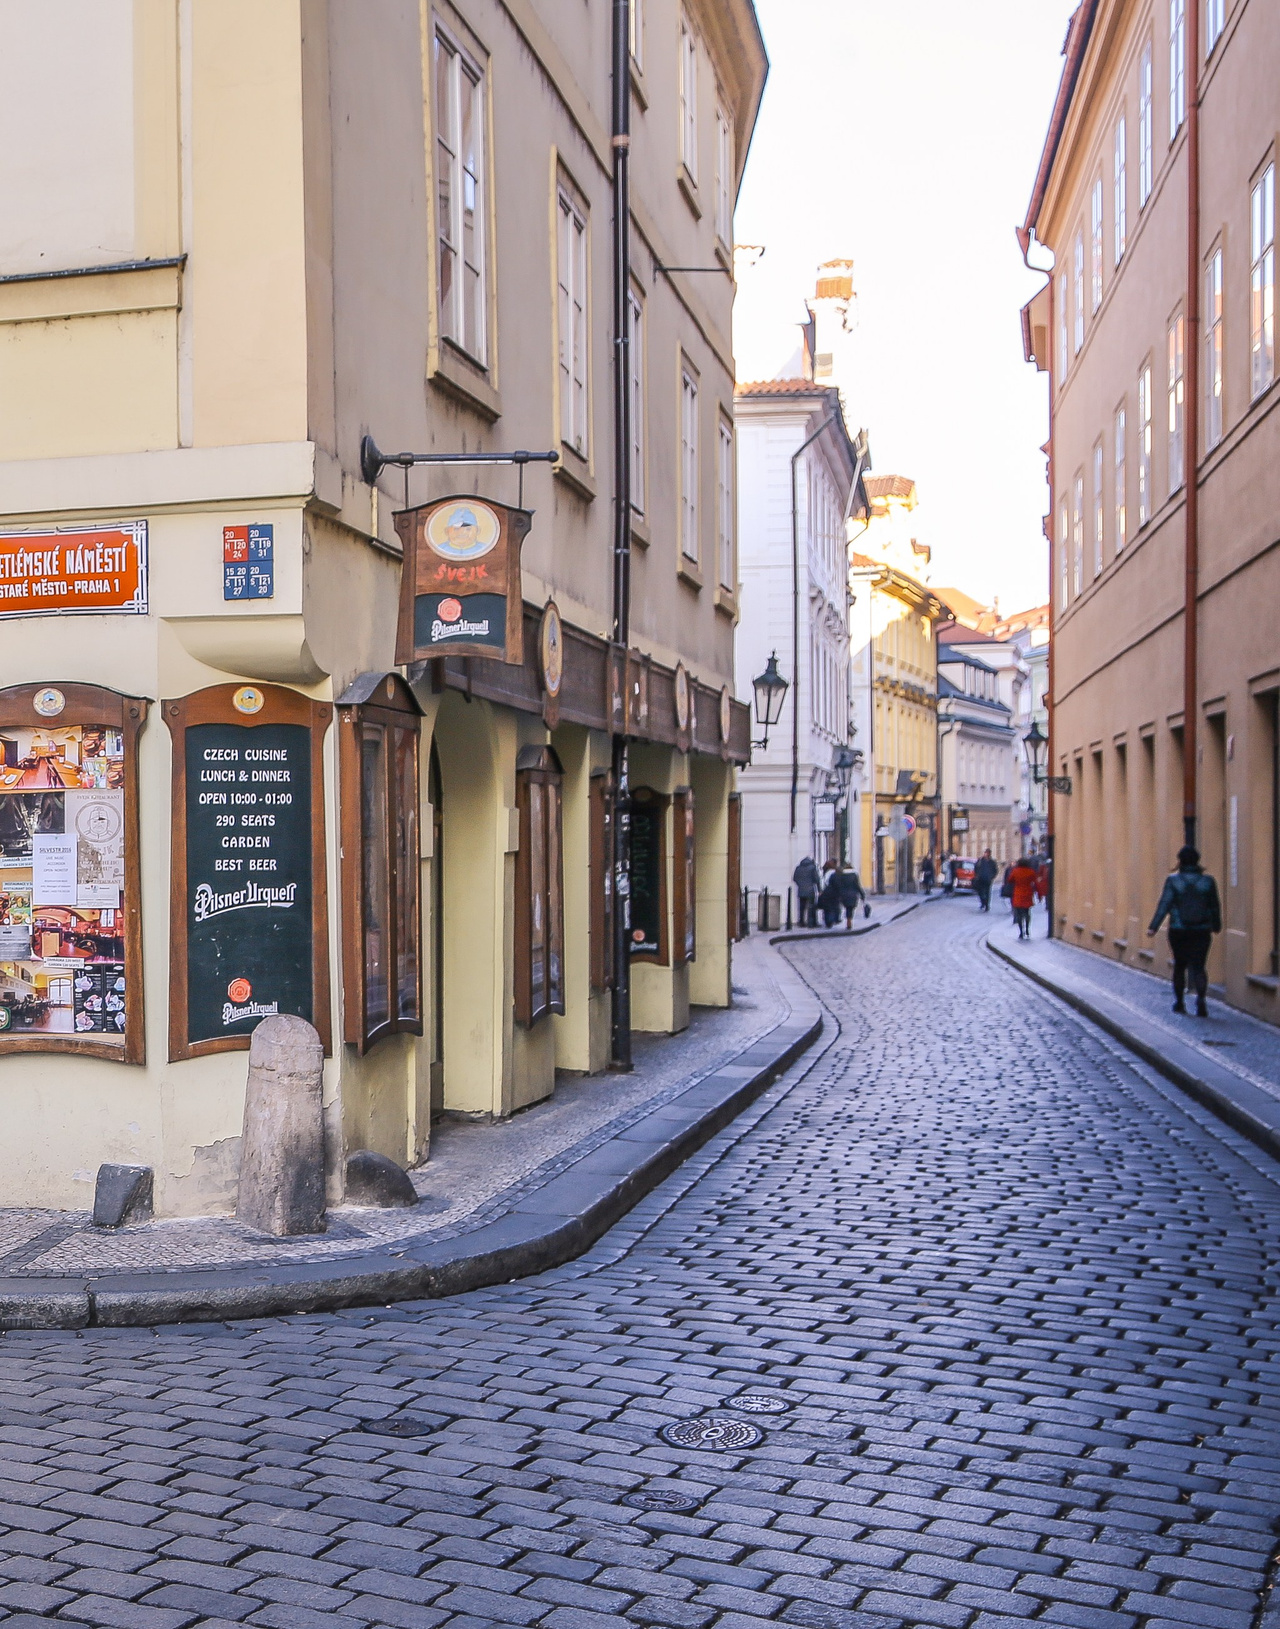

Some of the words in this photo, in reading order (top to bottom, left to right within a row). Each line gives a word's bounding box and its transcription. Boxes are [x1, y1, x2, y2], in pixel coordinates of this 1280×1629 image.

[225, 531, 234, 539] 20
[250, 529, 259, 537] 20
[65, 541, 128, 575] NÁMĚSTÍ
[233, 551, 242, 559] 24
[258, 549, 266, 557] 31
[237, 567, 246, 575] 20
[250, 566, 259, 574] 20
[113, 578, 120, 593] 1
[238, 578, 245, 586] 11
[263, 577, 271, 585] 21
[233, 586, 242, 595] 27
[258, 586, 267, 594] 20
[431, 619, 461, 642] Pilsner
[460, 618, 490, 636] Urquell
[203, 749, 238, 762] CZECH
[244, 749, 287, 762] CUISINE
[200, 770, 236, 782] LUNCH
[239, 771, 248, 782] &
[251, 770, 291, 783] DINNER
[198, 793, 227, 805] OPEN
[230, 793, 257, 805] 10:00
[264, 792, 292, 805] 01:00
[215, 814, 235, 827] 290
[241, 814, 276, 827] SEATS
[221, 836, 270, 848] GARDEN
[215, 858, 243, 872] BEST
[249, 858, 277, 871] BEER
[194, 883, 246, 923] Pilsner
[246, 879, 297, 909] Urquell
[222, 1002, 251, 1026] Pilsner
[250, 1000, 278, 1016] Urquell
